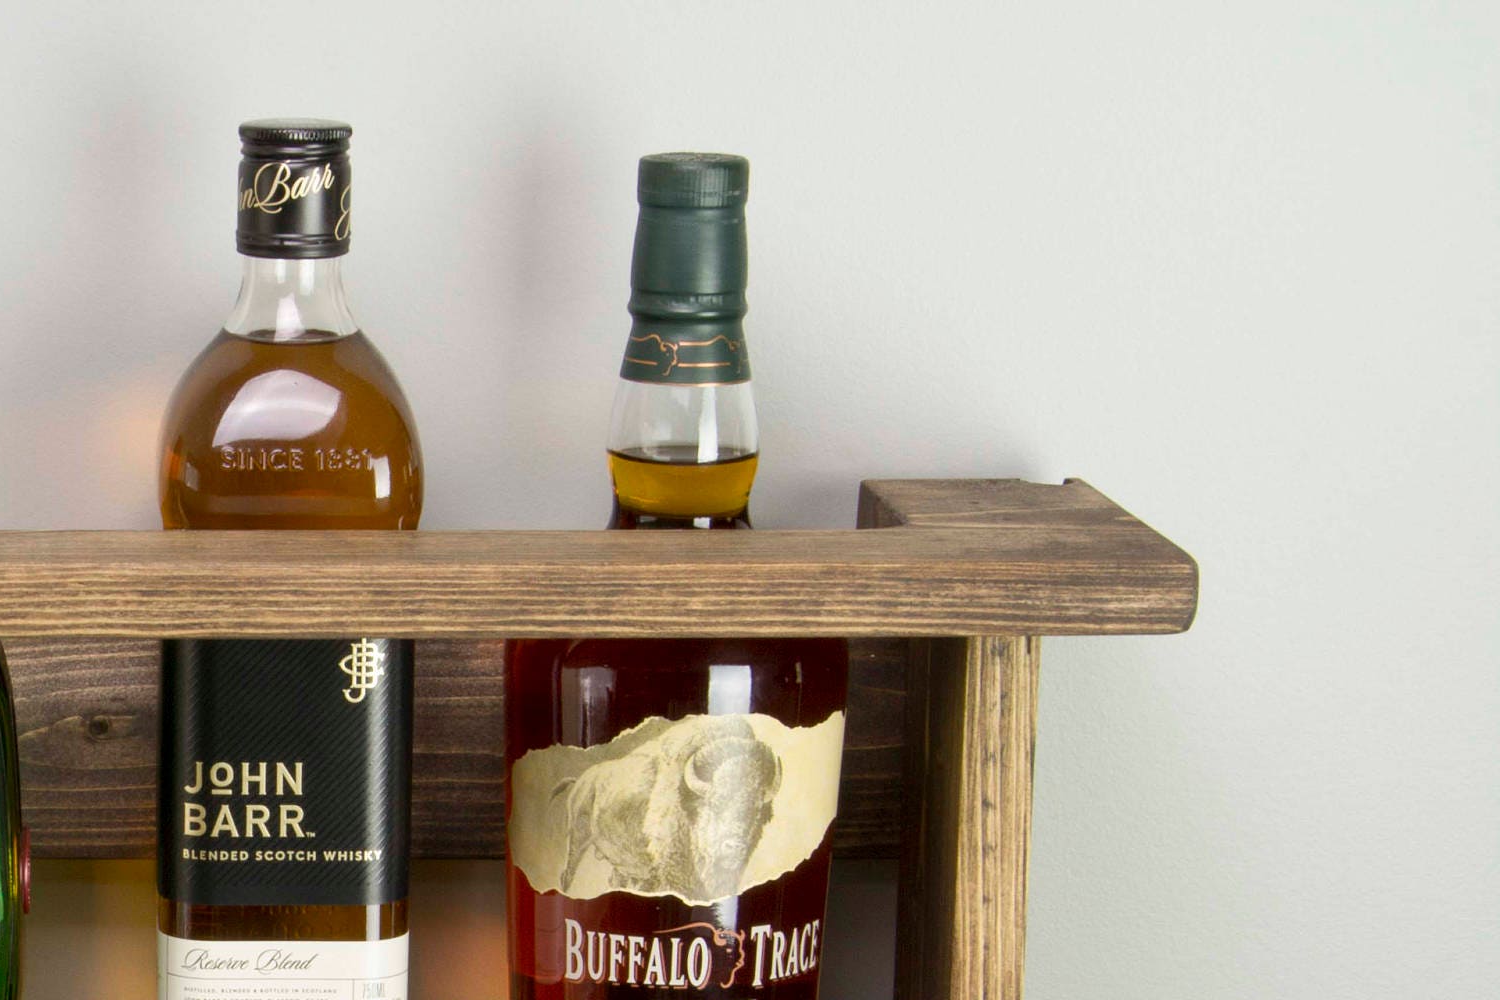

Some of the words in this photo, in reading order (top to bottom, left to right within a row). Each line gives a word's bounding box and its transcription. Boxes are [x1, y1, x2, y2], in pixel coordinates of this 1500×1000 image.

[254, 162, 335, 214] Barr
[220, 446, 304, 471] SINCE
[184, 761, 303, 795] JOHN
[183, 849, 248, 861] BLENDED
[255, 851, 317, 861] SCOTCH
[323, 850, 382, 861] WHISKY
[180, 948, 250, 971] Reserve
[253, 948, 319, 975] Blend
[564, 918, 713, 990] BUFFALO
[751, 919, 821, 989] TRACE
